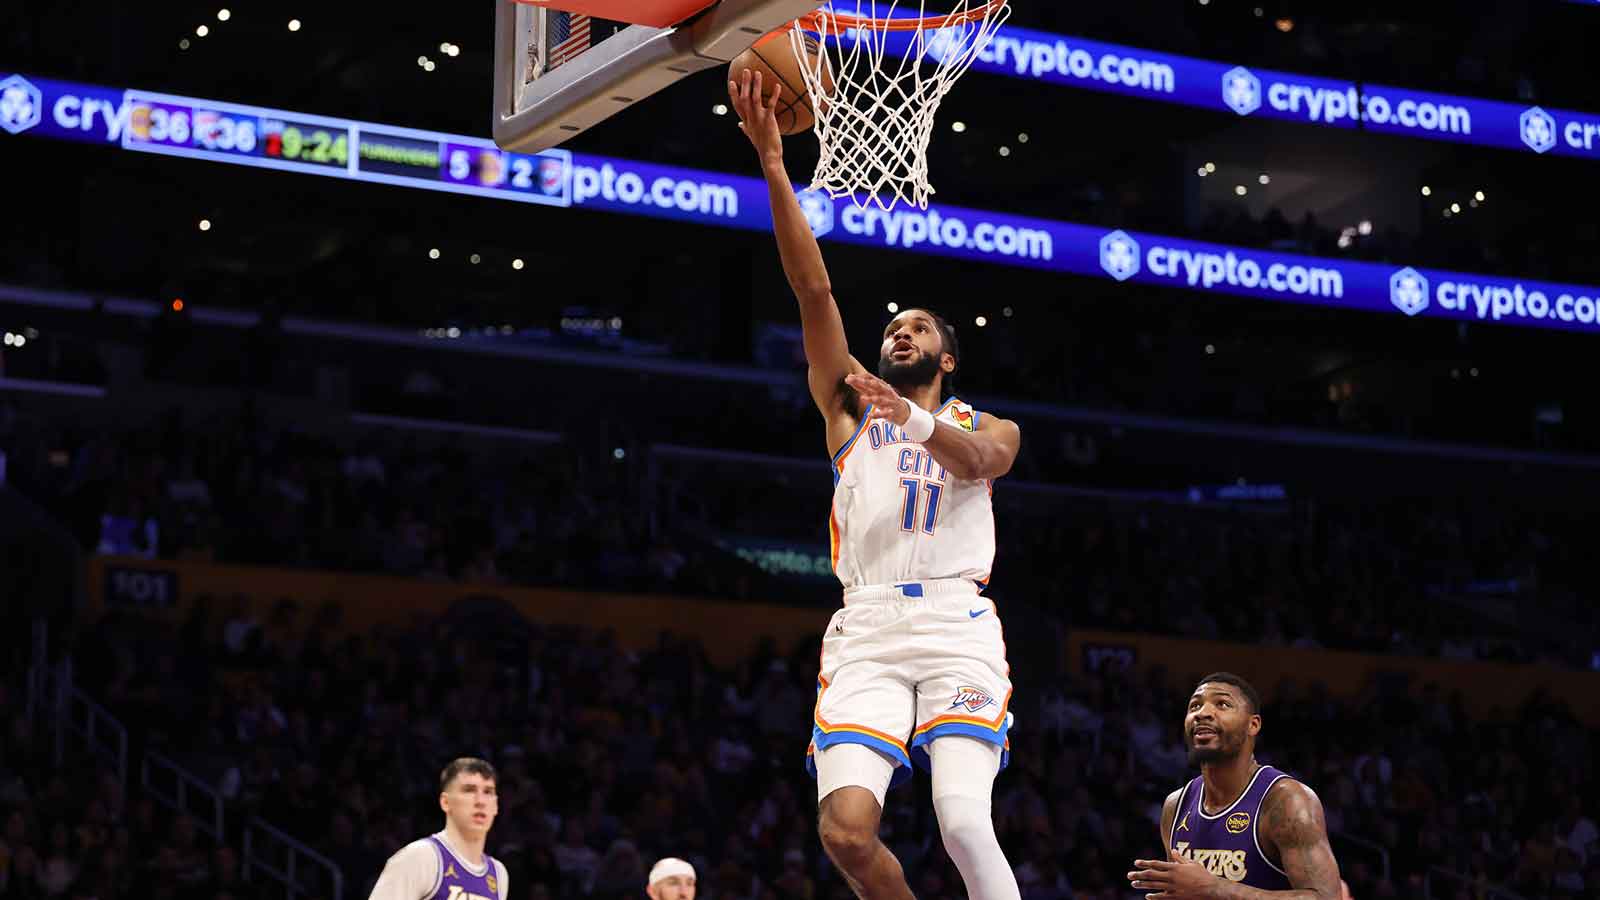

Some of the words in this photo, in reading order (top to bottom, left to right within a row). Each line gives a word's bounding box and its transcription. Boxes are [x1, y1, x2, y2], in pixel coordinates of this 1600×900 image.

[974, 33, 1175, 93] crypto.com
[1267, 82, 1471, 134] crypto.com
[1564, 121, 1600, 150] cr
[449, 150, 470, 180] 5
[510, 157, 533, 188] 2
[841, 202, 1053, 260] crypto.com
[1146, 244, 1344, 298] crypto.com
[1435, 279, 1600, 325] crypto.co
[899, 477, 944, 536] 11
